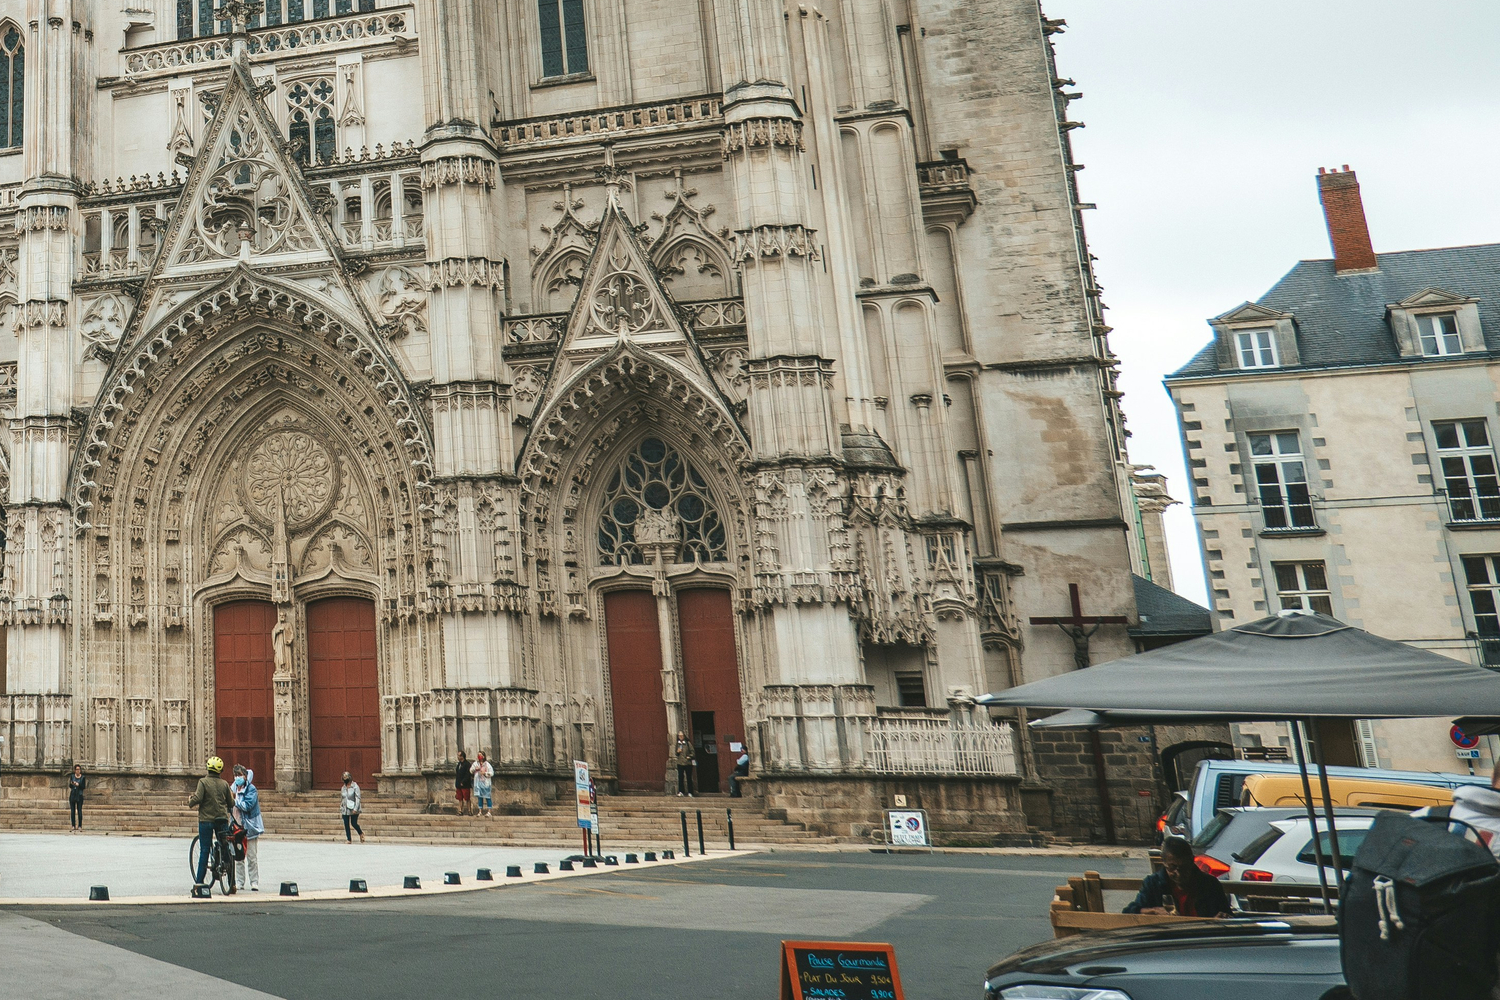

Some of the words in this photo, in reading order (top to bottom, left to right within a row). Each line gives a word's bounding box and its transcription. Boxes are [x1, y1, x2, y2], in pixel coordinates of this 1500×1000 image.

[808, 953, 834, 966] Pause
[838, 953, 886, 967] Gourmande
[810, 987, 845, 996] SALADES
[871, 989, 894, 999] 9,90€
